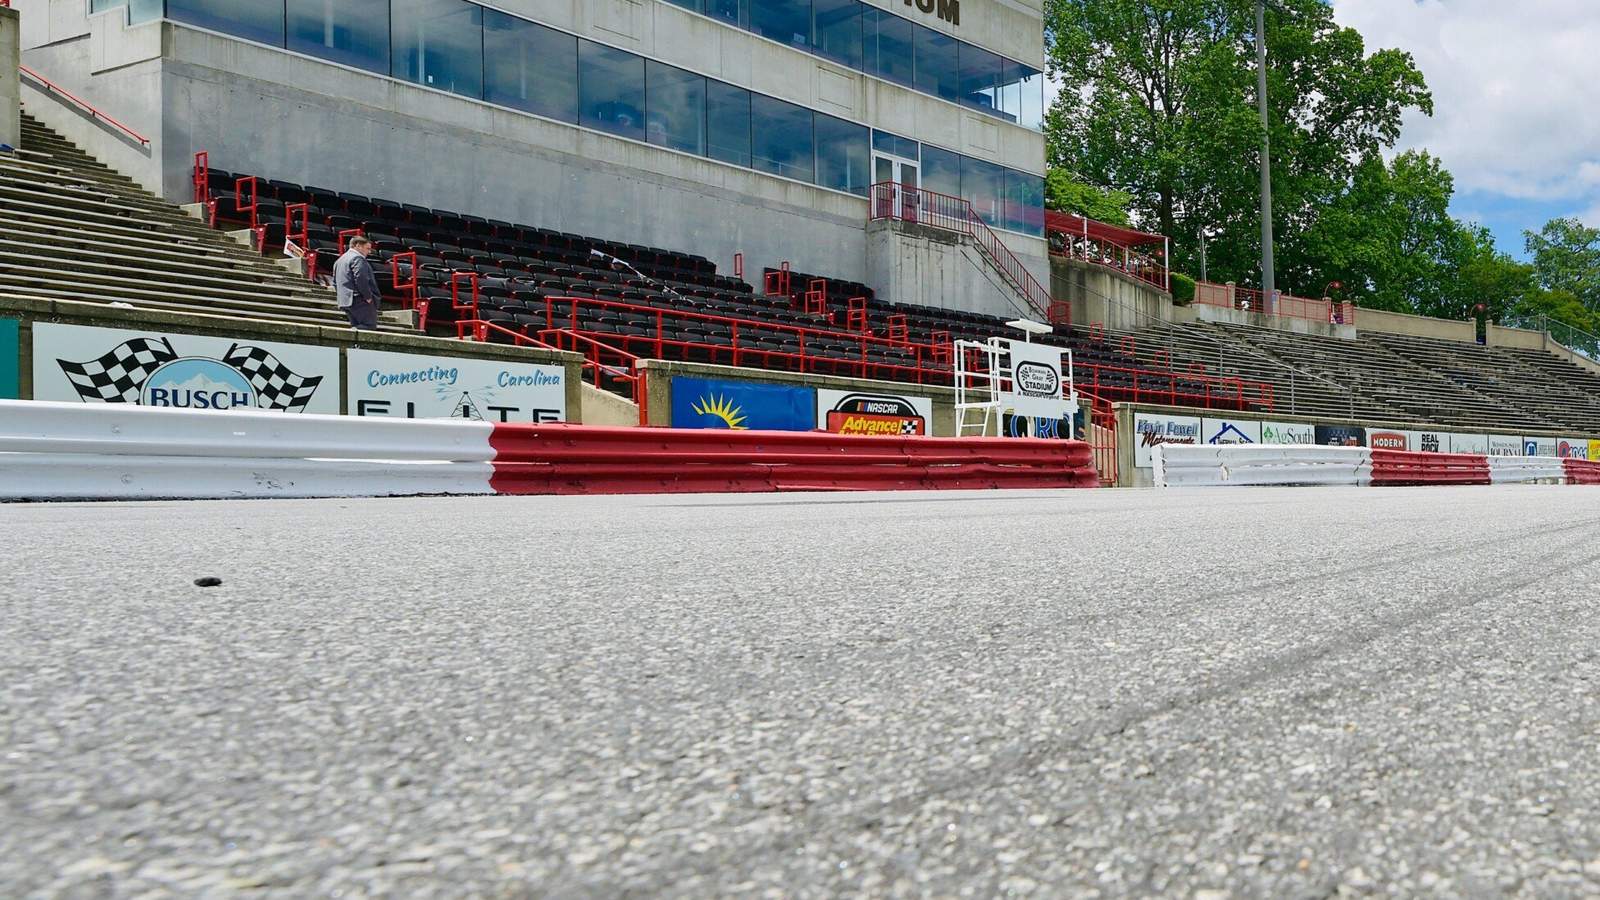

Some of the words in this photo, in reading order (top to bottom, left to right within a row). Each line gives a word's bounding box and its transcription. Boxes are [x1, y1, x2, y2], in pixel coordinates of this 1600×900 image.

[367, 366, 458, 387] Connecting
[497, 369, 560, 387] Carolina
[1024, 381, 1053, 391] STADIUM
[150, 388, 249, 409] BUSCH
[867, 402, 899, 414] NASCAR
[842, 416, 898, 432] Advance
[1137, 420, 1164, 435] Kevin
[1273, 427, 1314, 444] AgSouth
[1373, 438, 1403, 448] MODERN
[1421, 434, 1439, 443] REAL
